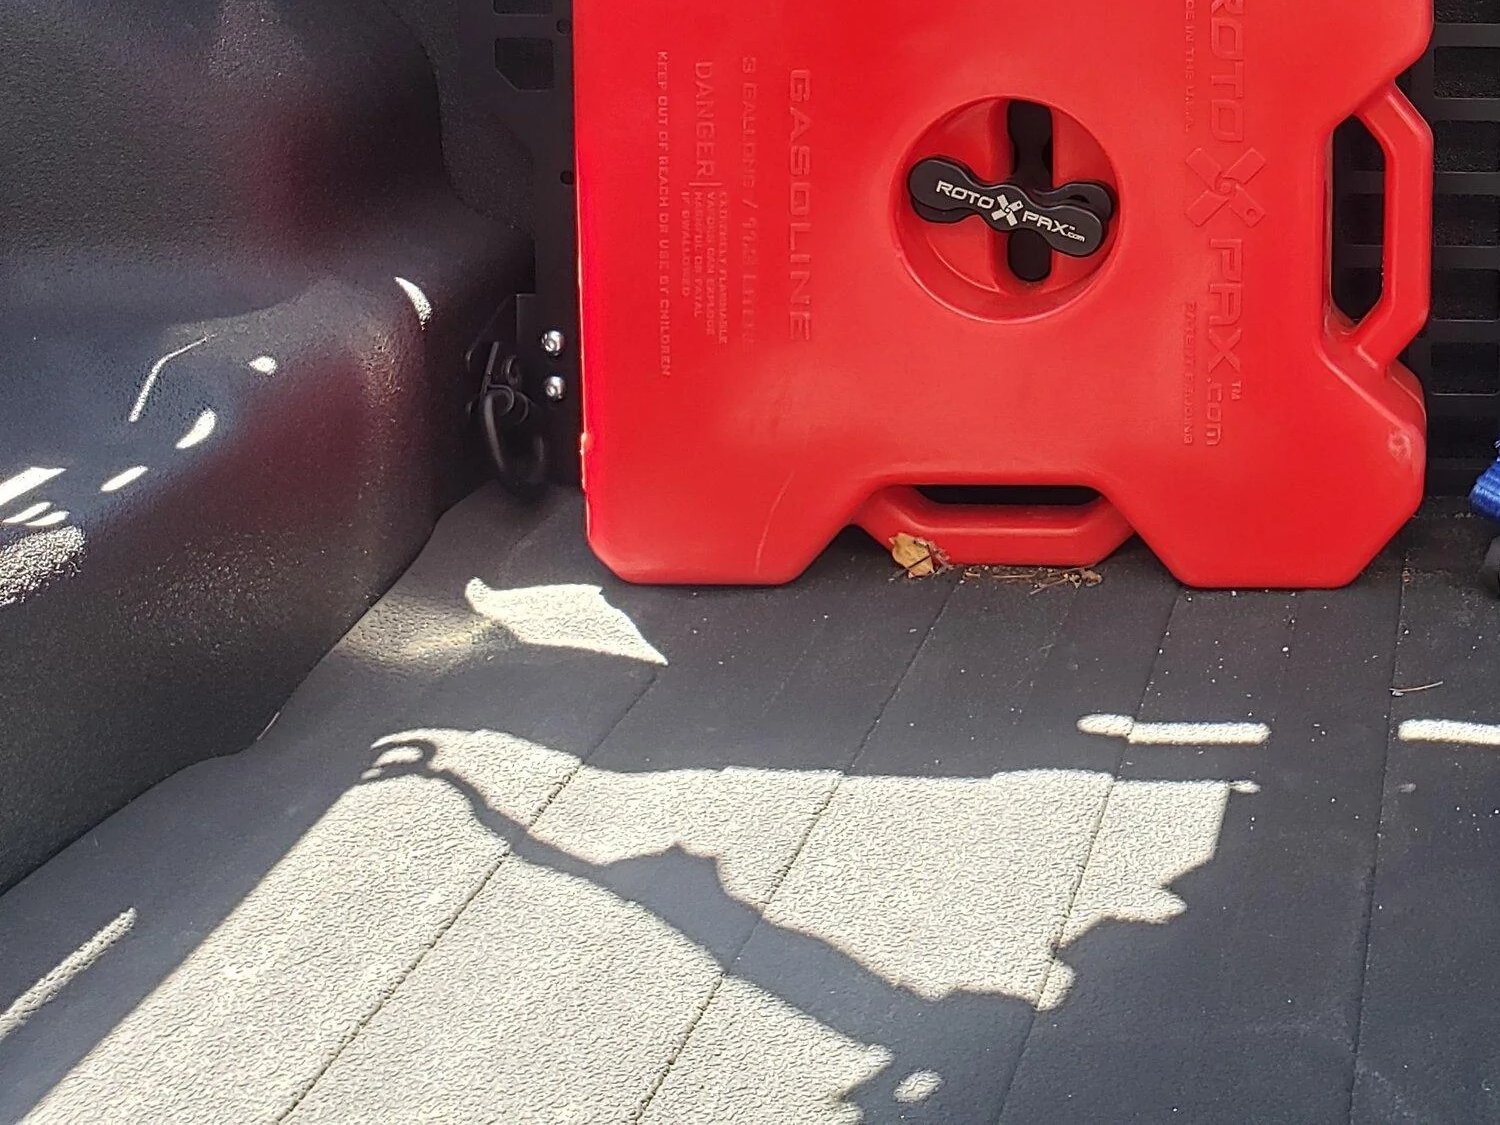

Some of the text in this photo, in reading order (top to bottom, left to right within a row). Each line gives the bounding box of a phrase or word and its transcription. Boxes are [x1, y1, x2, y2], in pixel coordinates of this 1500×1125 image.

[1183, 24, 1196, 43] IN
[1183, 46, 1197, 81] THE
[693, 60, 717, 177] DANGER
[740, 82, 759, 189] GALLONS
[656, 50, 672, 378] KEEP OUT OF REACH OR USE BY CHILDREN
[786, 67, 815, 342] GASOLINE
[936, 179, 996, 210] ROTO
[693, 190, 704, 251] HARMFUL
[705, 246, 716, 274] CAN
[693, 277, 704, 318] FATAL
